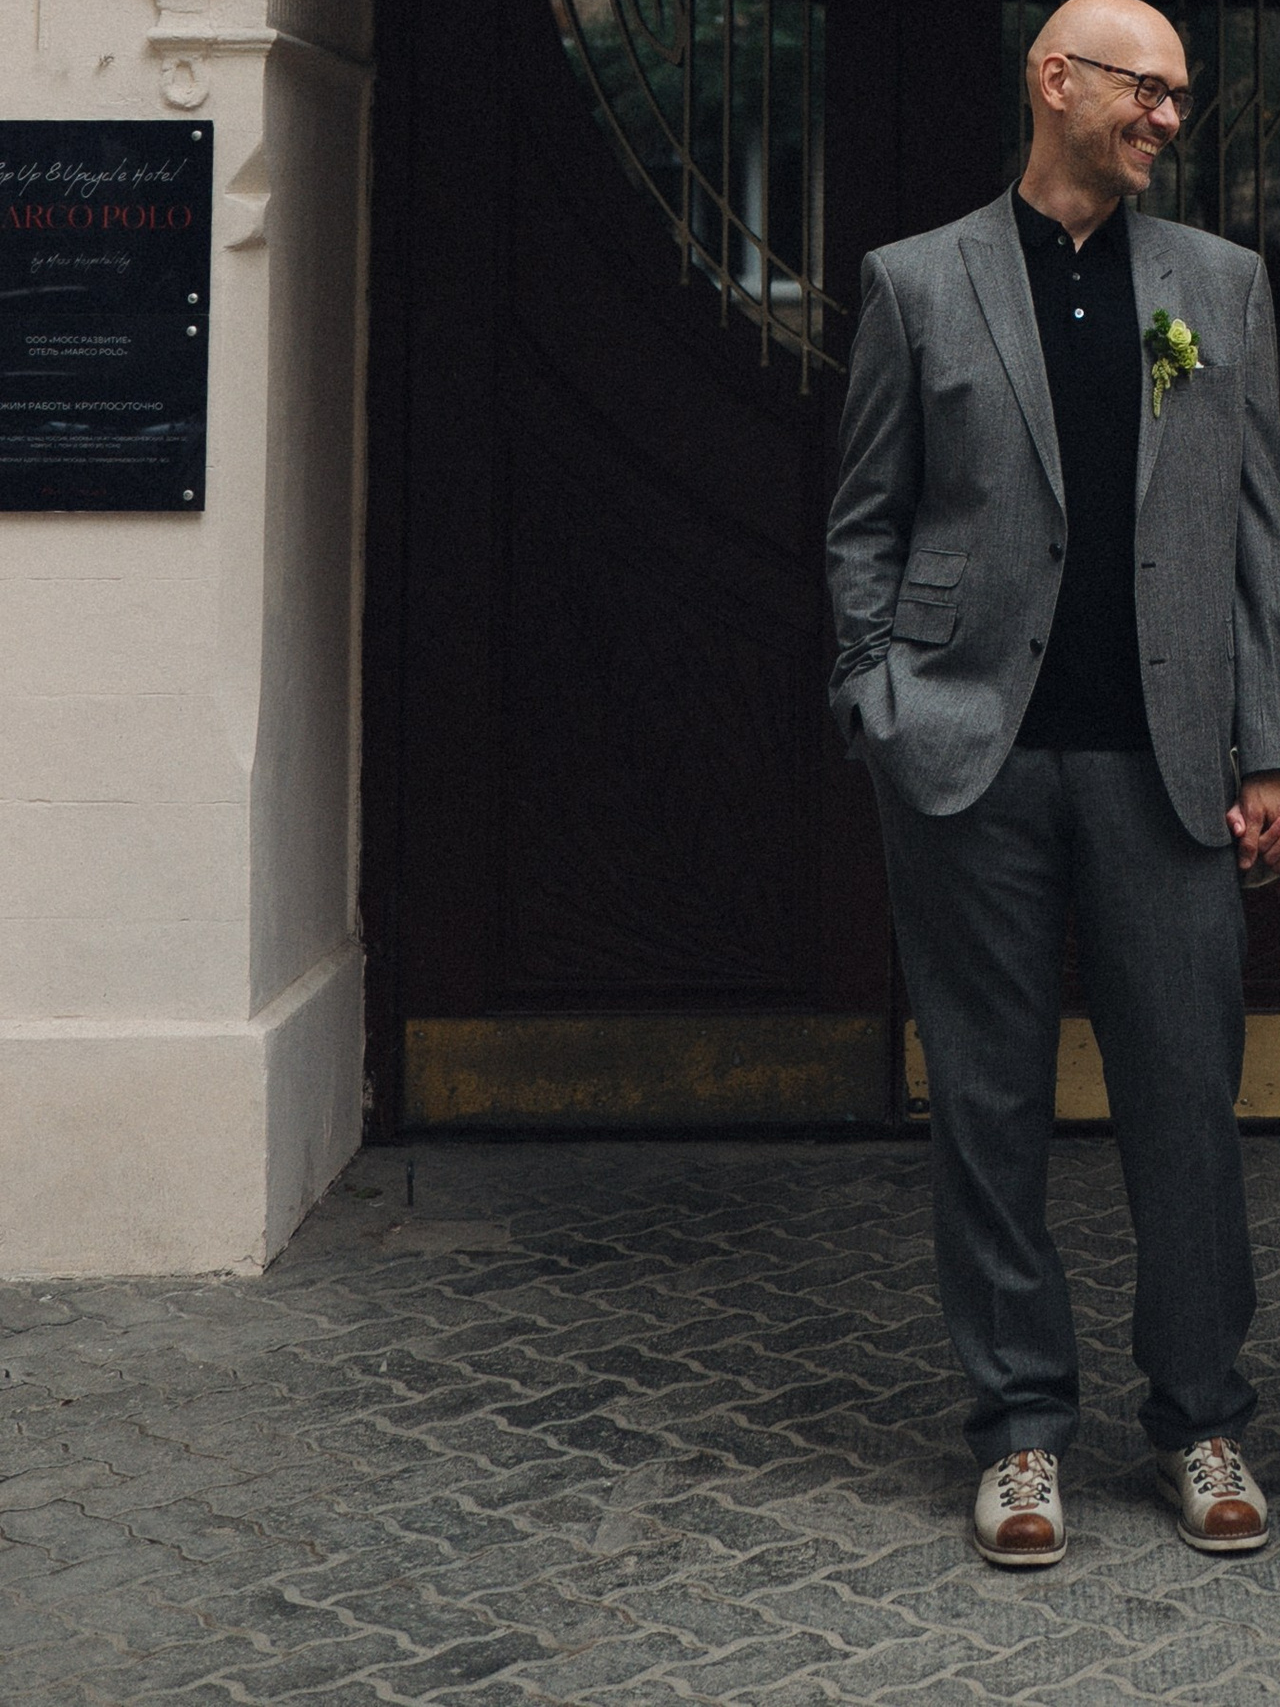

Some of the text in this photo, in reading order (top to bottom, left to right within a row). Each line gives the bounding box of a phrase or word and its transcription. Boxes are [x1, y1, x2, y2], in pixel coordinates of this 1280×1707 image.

[17, 161, 42, 197] Up
[45, 161, 62, 181] &
[63, 157, 128, 199] Upcycle
[131, 157, 188, 190] Hotel
[99, 204, 192, 230] POLO
[28, 347, 59, 356] ОТЕЛЬ
[75, 401, 164, 411] КРУГЛОСУТОЧНО
